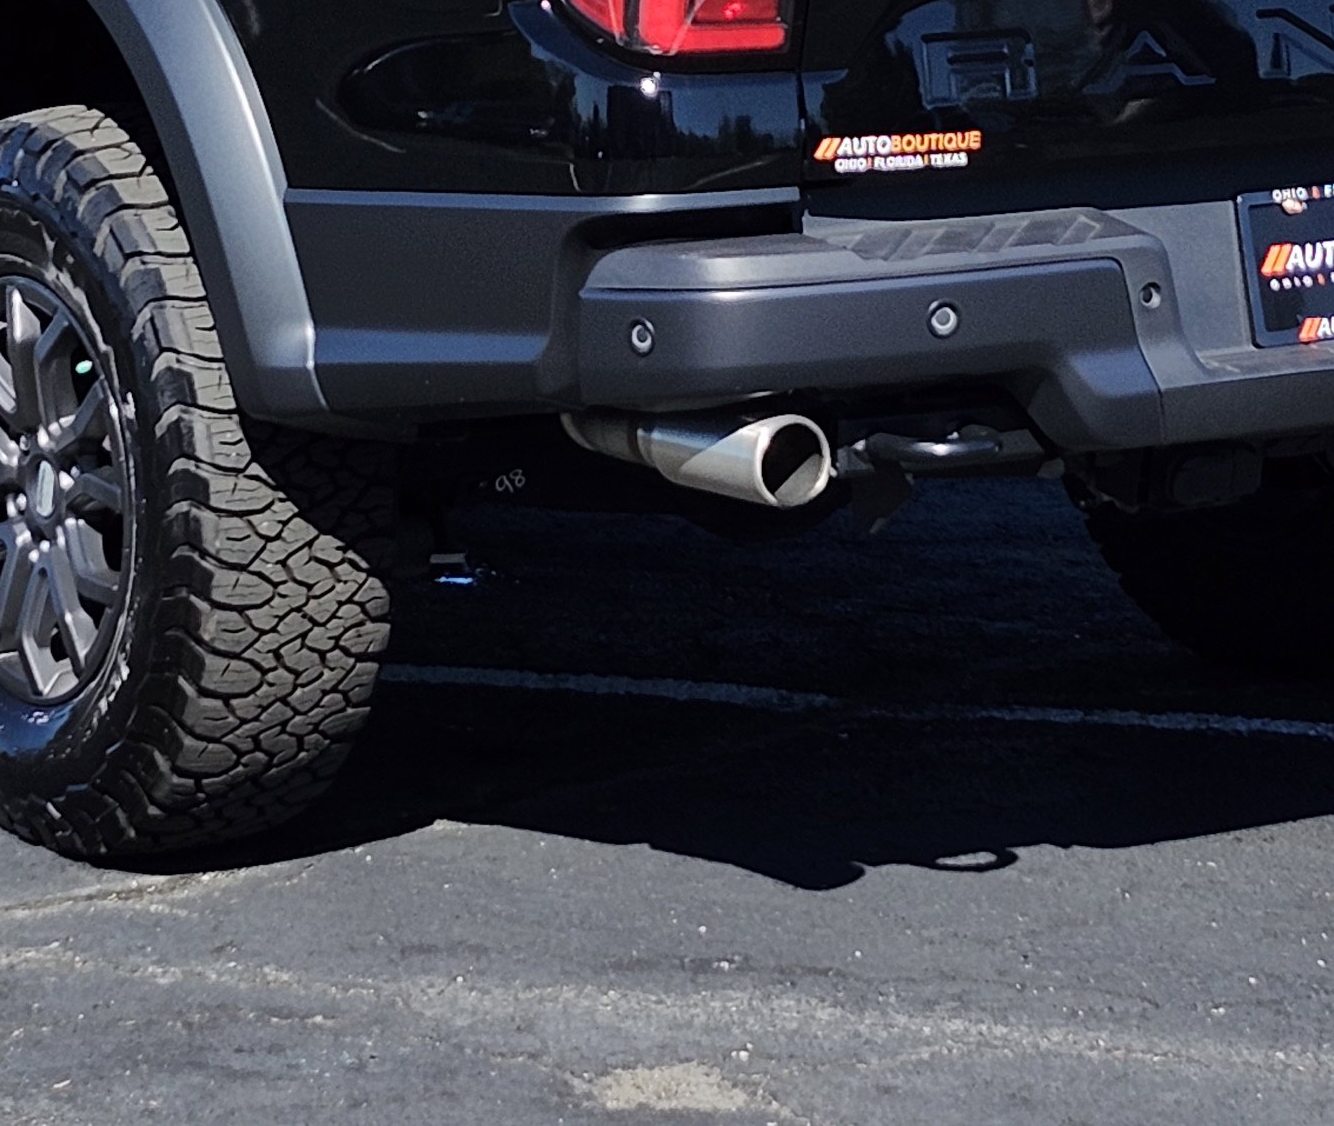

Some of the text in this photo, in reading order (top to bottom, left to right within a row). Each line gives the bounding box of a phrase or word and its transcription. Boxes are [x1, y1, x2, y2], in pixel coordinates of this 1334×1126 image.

[836, 130, 981, 156] AUTOBOUTIQUE
[835, 152, 968, 173] OHIO FLORIDA TEXAS
[1272, 187, 1308, 203] OHIO
